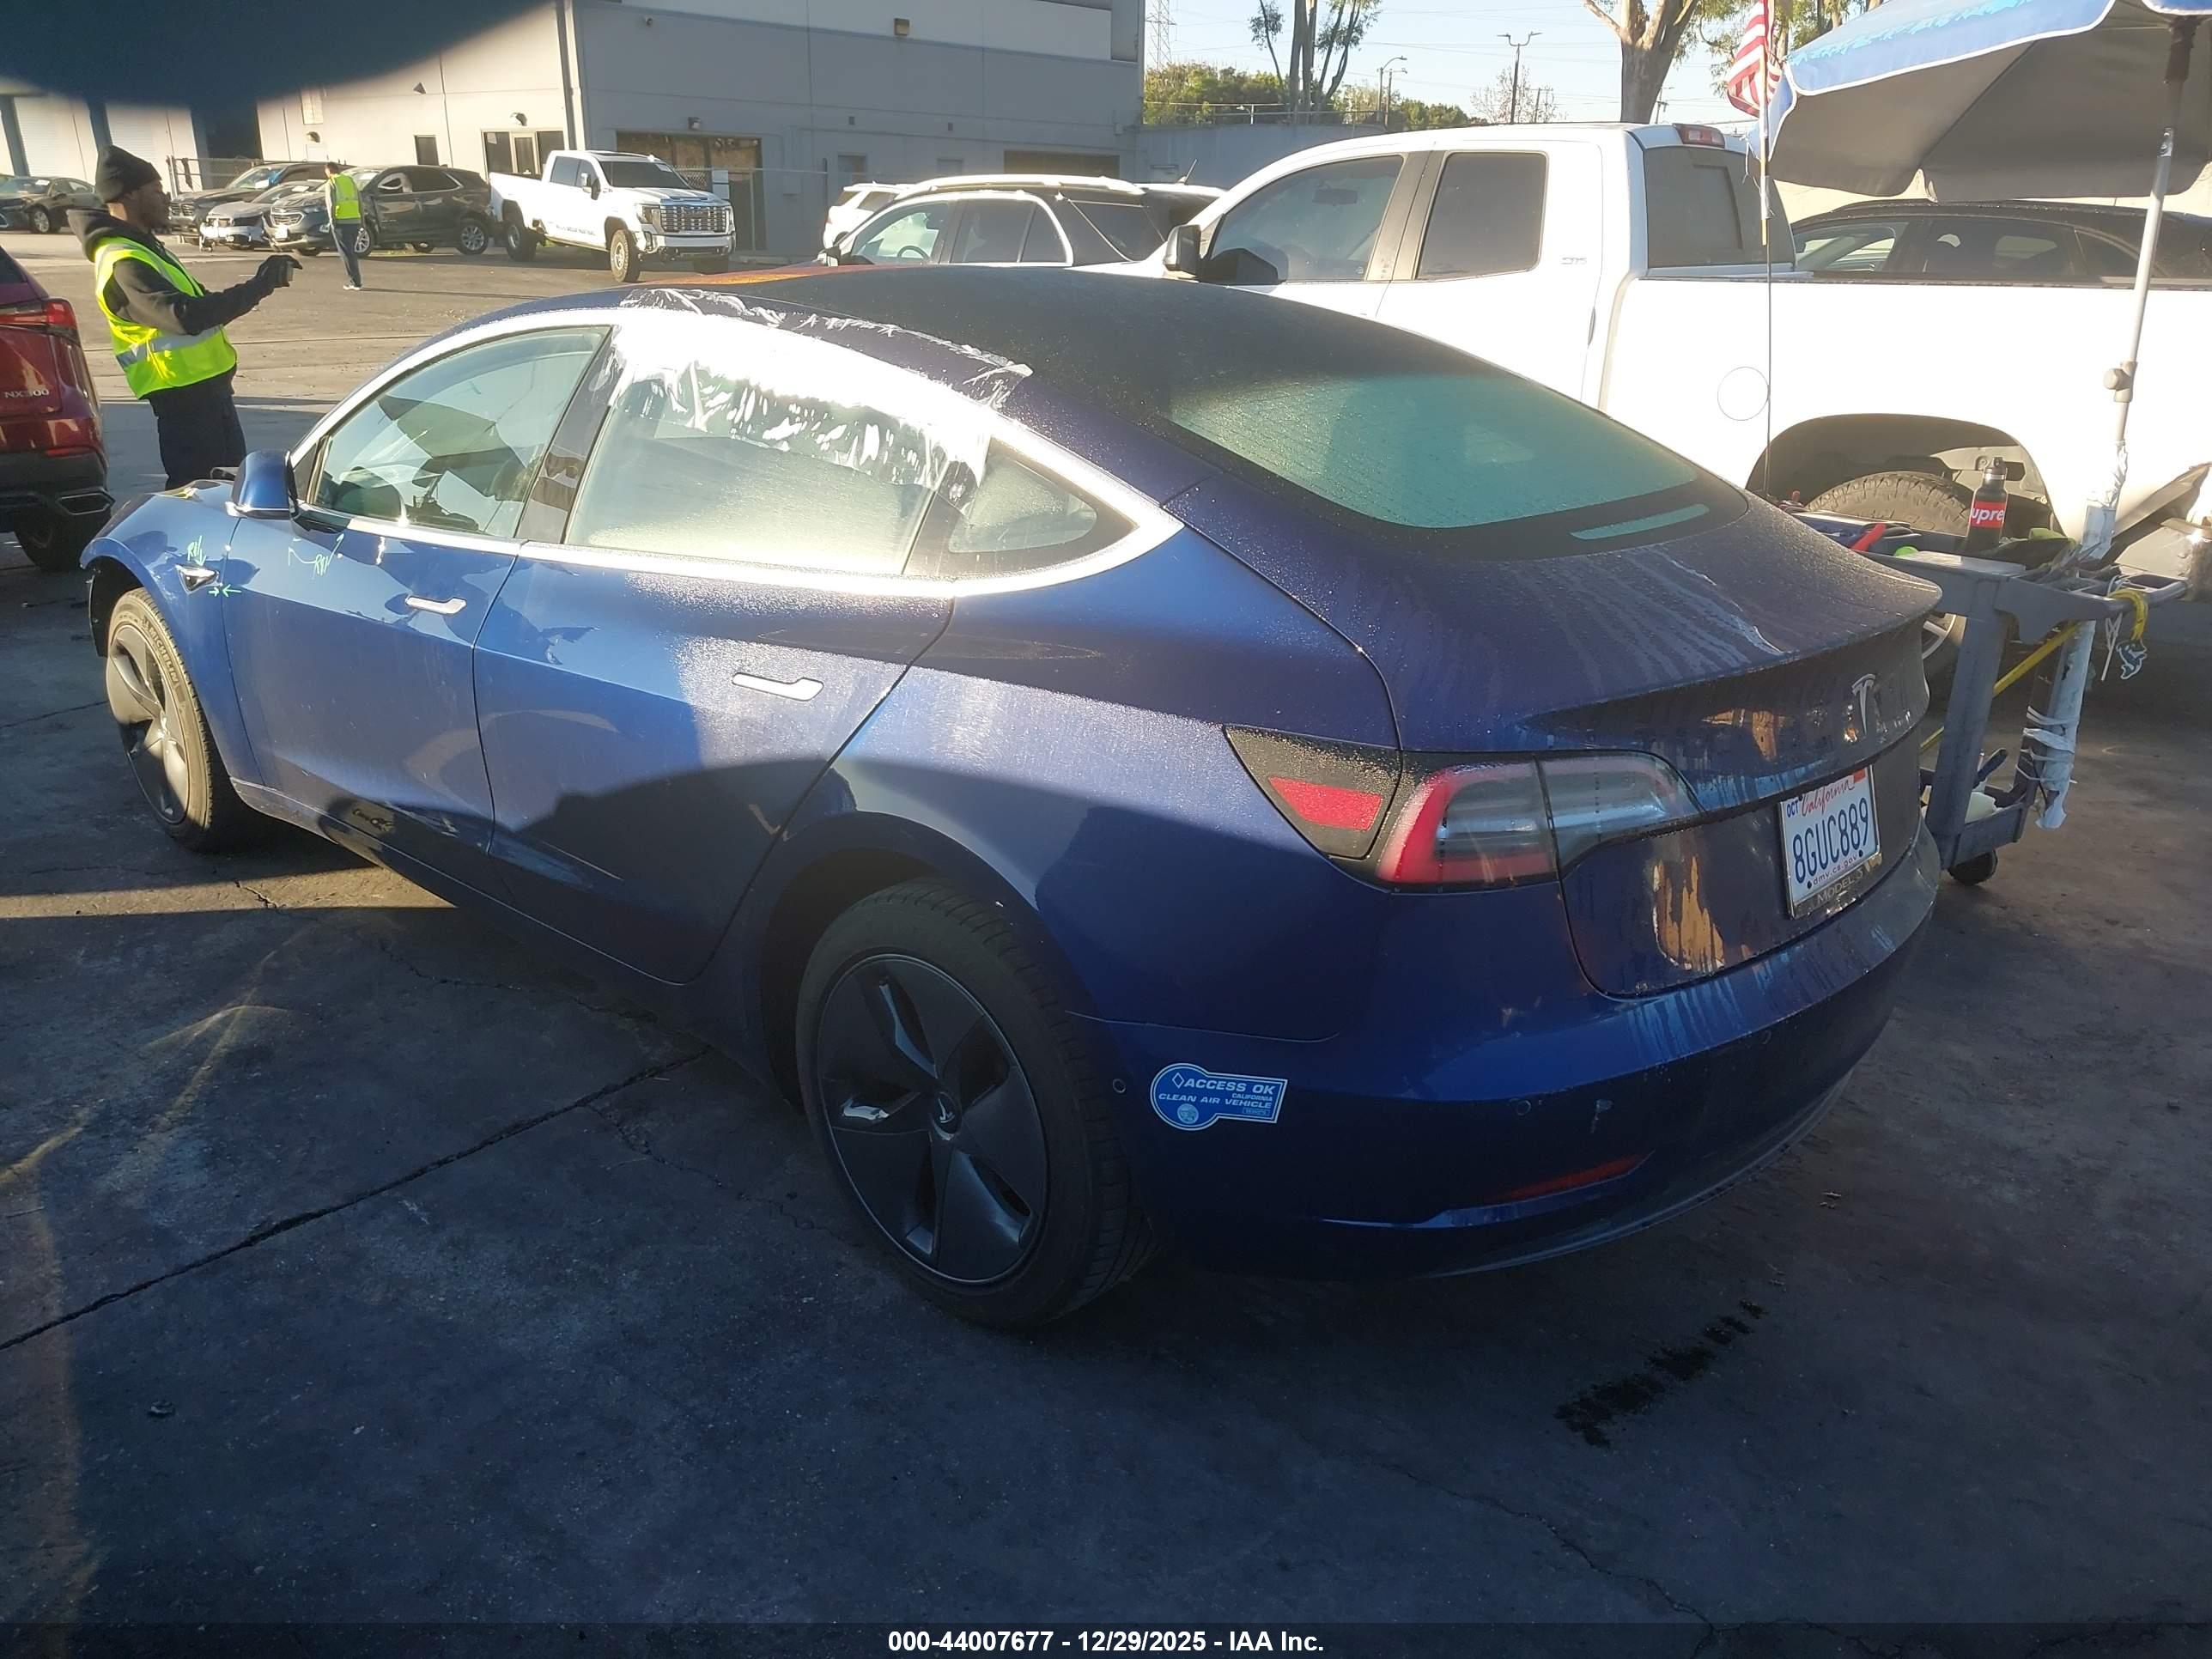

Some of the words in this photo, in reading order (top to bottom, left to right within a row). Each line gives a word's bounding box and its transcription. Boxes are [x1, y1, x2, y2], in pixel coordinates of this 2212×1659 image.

[148, 625, 179, 685] MICHELIN
[1786, 799, 1799, 817] OCT
[1802, 779, 1855, 817] California
[1792, 797, 1869, 884] 8GUC889
[1813, 854, 1858, 886] dmv.ca.gov
[1817, 876, 1856, 903] MODEL
[1158, 1092, 1197, 1103] CLEAN
[1200, 1096, 1220, 1104] AIR
[1224, 1098, 1273, 1109] VEHICLE
[1183, 1078, 1247, 1092] ACCESS
[1252, 1084, 1276, 1095] OK
[1231, 1092, 1273, 1102] CALIFORNIA
